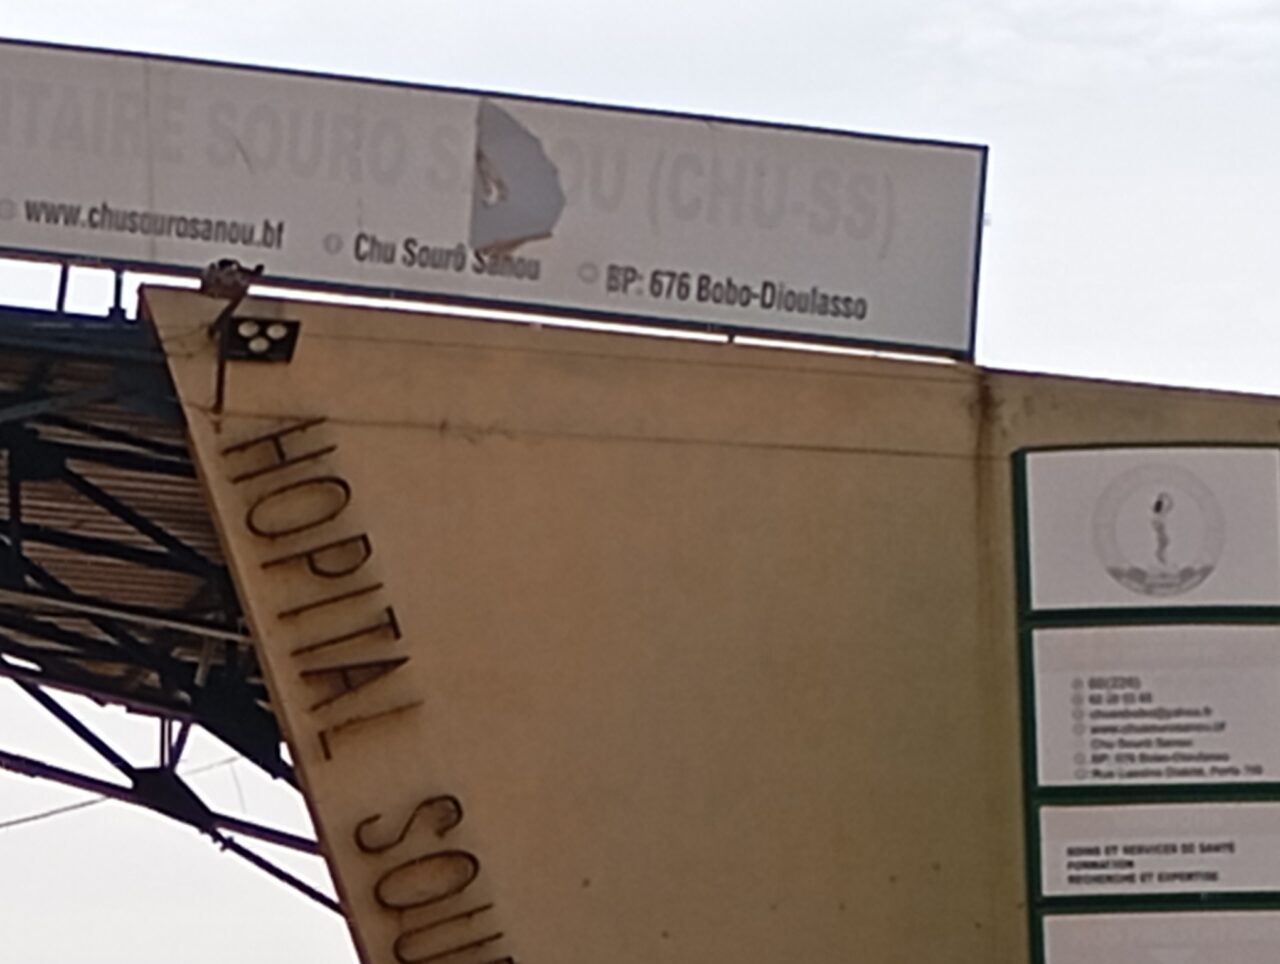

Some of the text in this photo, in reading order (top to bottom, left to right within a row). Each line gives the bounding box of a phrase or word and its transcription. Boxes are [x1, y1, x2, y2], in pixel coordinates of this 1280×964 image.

[24, 200, 285, 250] www.chusourosanou.bf
[353, 231, 397, 265] Chu
[648, 268, 692, 302] 676
[695, 272, 868, 321] Bobo-Dioulasso
[221, 414, 425, 762] HOPITAL
